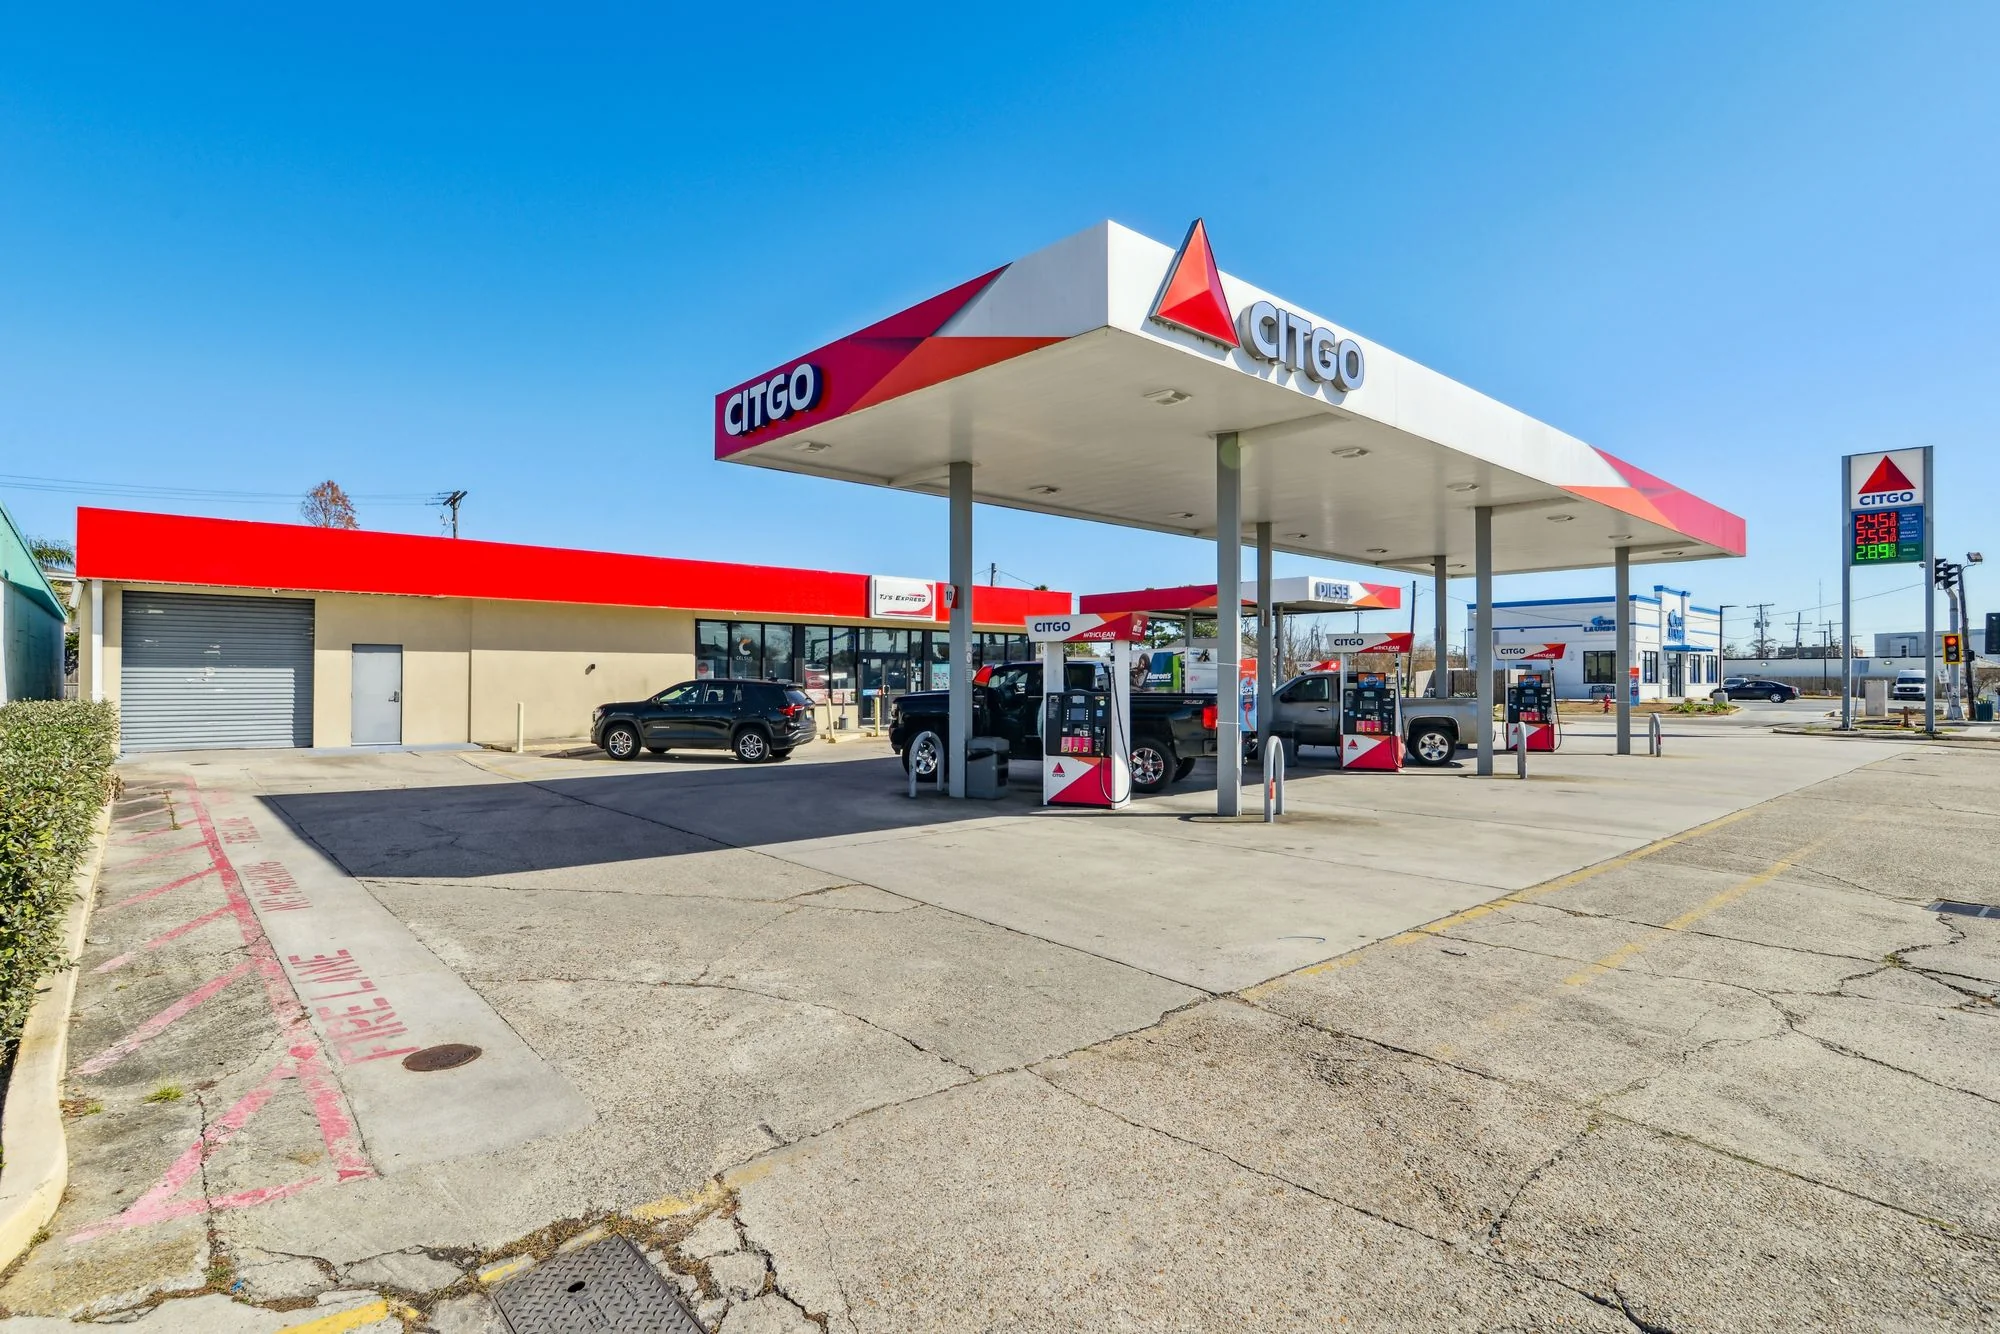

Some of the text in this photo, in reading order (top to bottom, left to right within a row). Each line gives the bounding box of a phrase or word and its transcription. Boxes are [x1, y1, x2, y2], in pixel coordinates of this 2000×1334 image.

[1240, 300, 1365, 392] CITGO
[724, 363, 817, 436] CITGO
[1859, 491, 1914, 506] CITGO
[946, 591, 953, 601] 10
[1316, 582, 1352, 599] DIESEL
[1035, 621, 1071, 633] CITGO
[1334, 638, 1364, 647] CITGO
[1501, 647, 1526, 655] CITGO
[1146, 671, 1173, 680] Aaron's
[287, 948, 422, 1066] FIRE LANE
